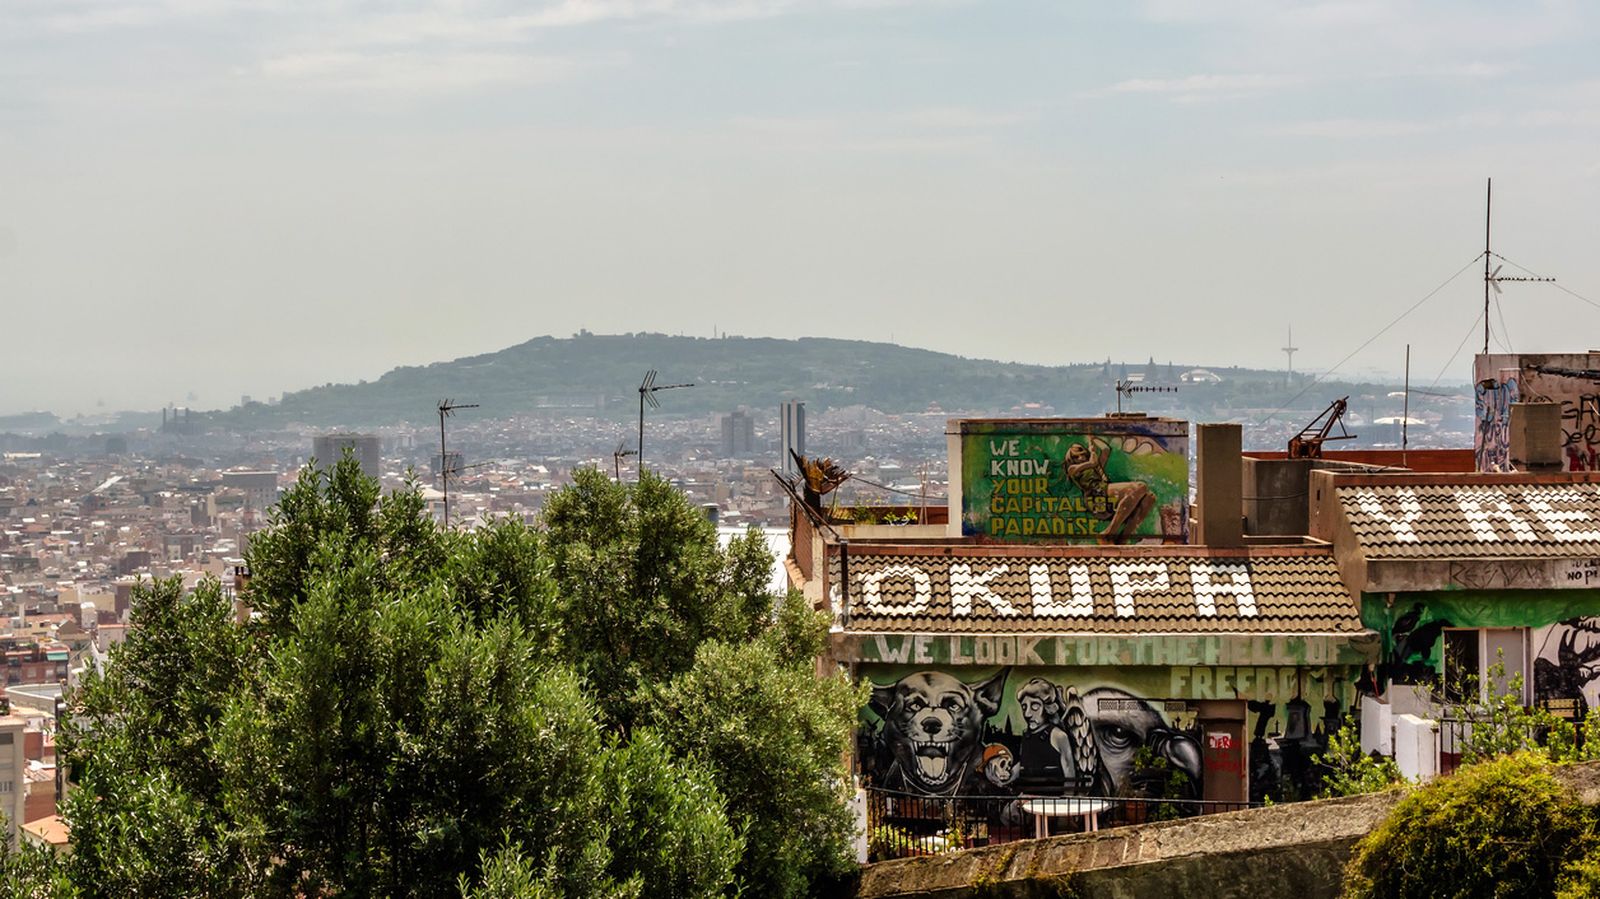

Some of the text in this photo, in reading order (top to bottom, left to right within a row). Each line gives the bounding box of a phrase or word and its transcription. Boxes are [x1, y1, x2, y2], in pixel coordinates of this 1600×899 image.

[990, 440, 1020, 456] WE
[991, 459, 1049, 477] KNOW
[991, 478, 1049, 494] YOUR
[1355, 488, 1600, 543] Y RE
[950, 635, 1046, 665] LOOK
[1055, 636, 1124, 665] FOR
[1127, 636, 1203, 665] THE
[1205, 636, 1297, 665] HELL
[1305, 636, 1349, 665] OF
